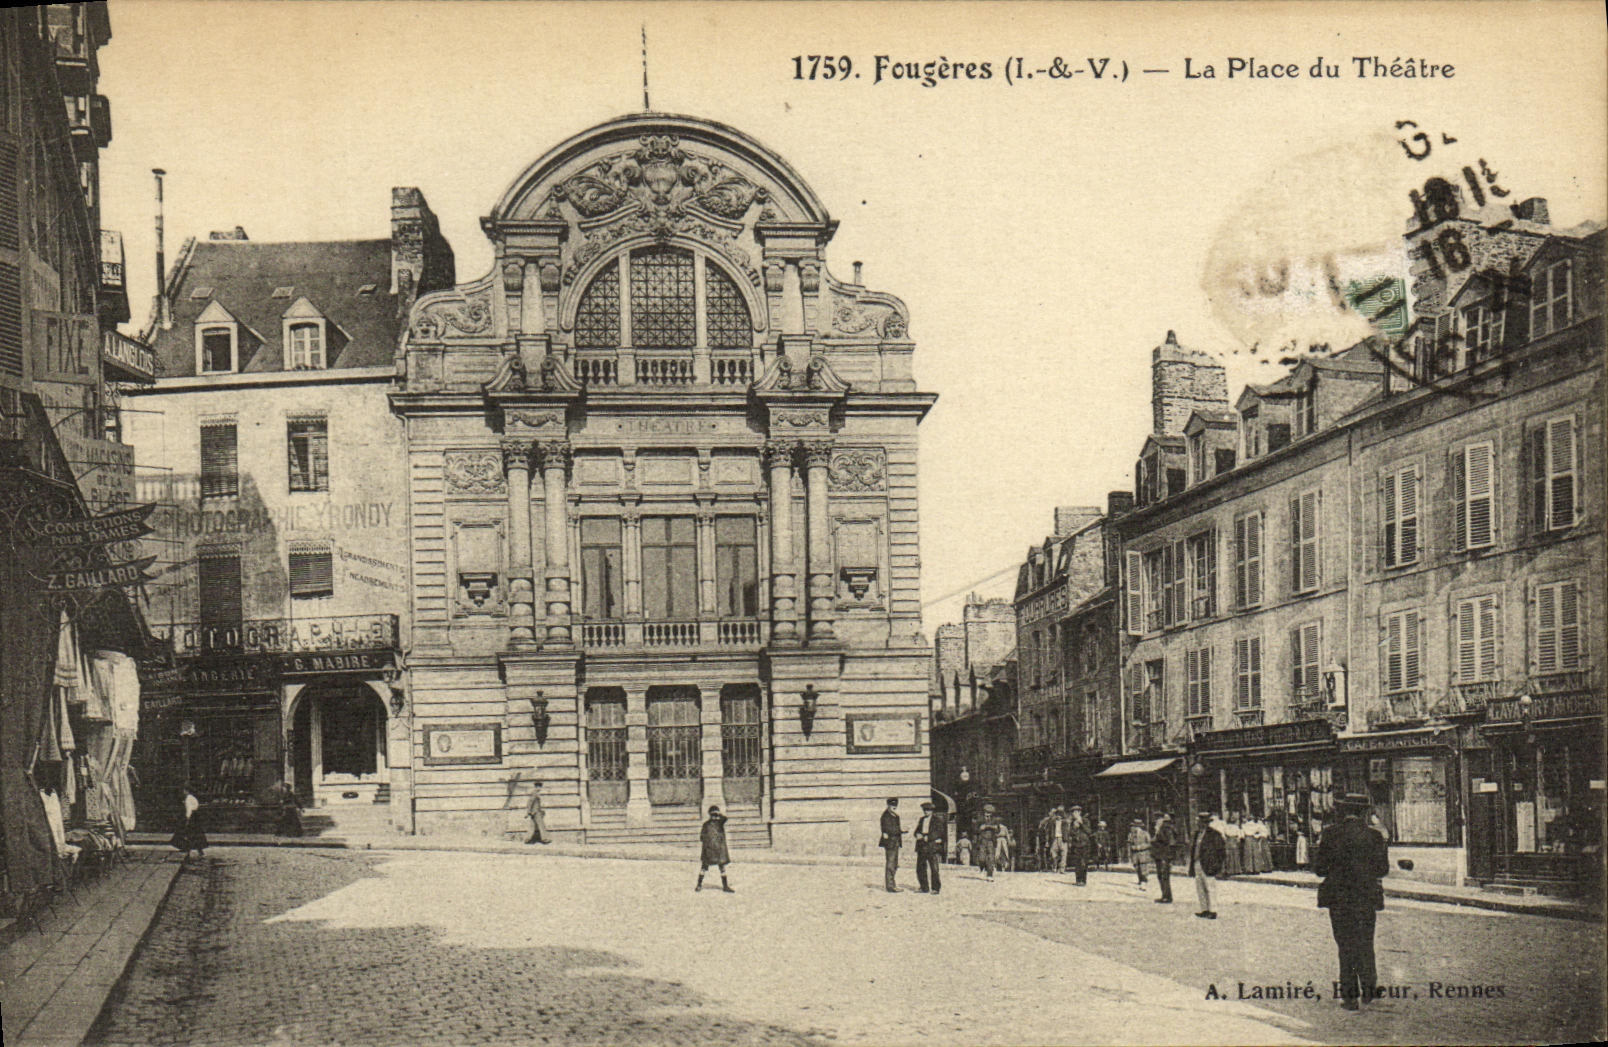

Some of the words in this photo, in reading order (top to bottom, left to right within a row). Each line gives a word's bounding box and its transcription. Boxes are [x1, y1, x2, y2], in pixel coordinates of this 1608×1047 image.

[44, 511, 141, 534] CONFECTIONS
[51, 535, 82, 546] POUR
[89, 523, 140, 543] DAMES
[65, 565, 139, 588] GAILLARD
[160, 621, 384, 651] HOTOGRAPHIE
[312, 655, 369, 670] MABIRE
